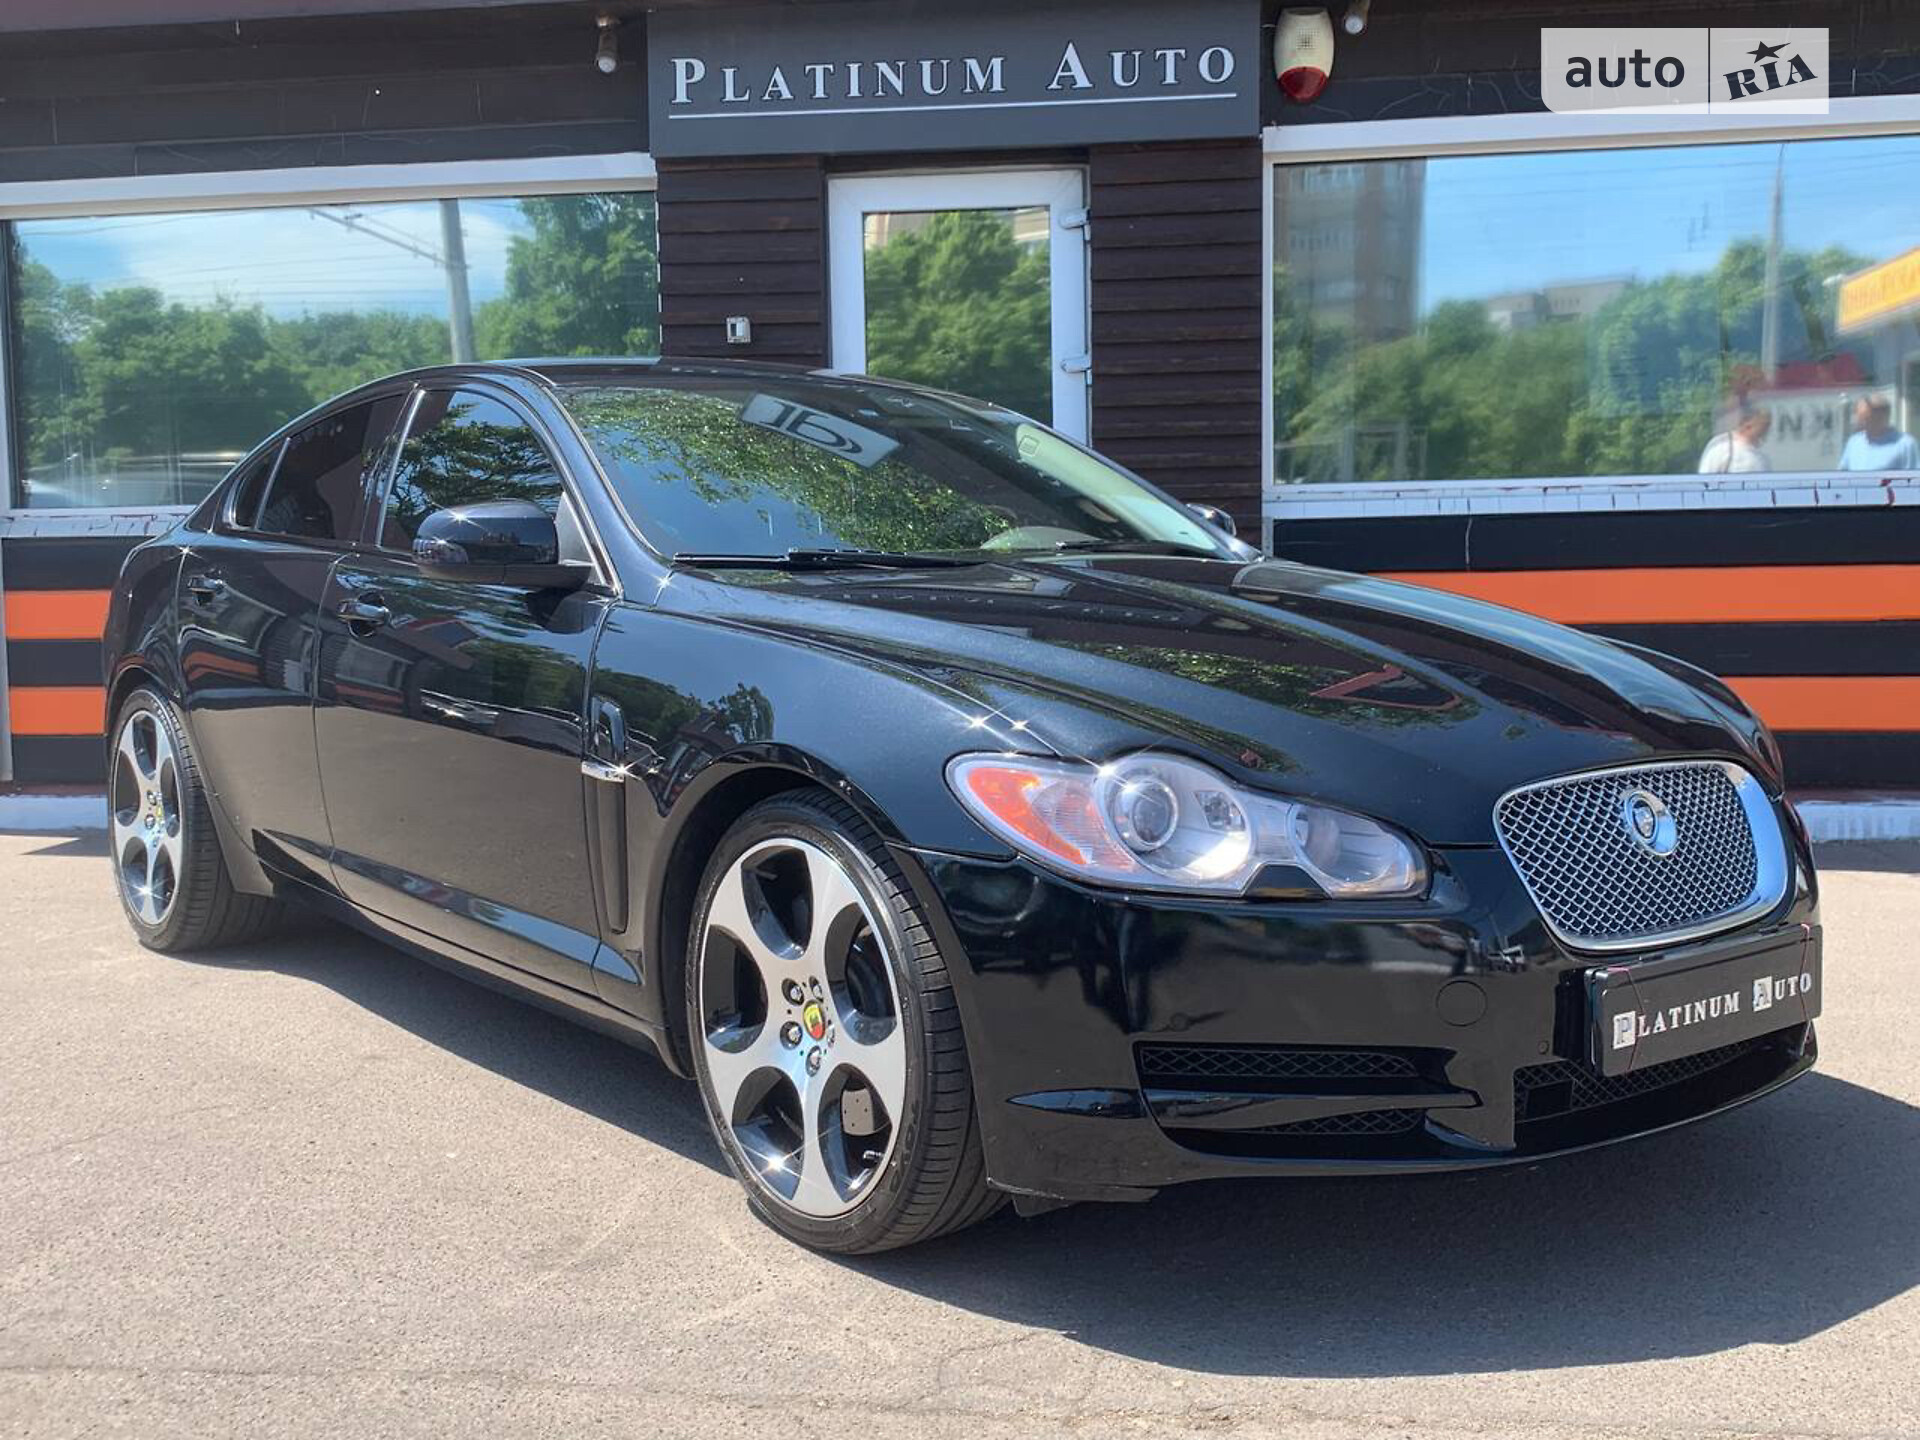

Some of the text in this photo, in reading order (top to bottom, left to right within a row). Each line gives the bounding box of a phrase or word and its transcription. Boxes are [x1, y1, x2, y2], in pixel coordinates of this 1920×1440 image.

[671, 41, 1236, 104] PLATINUM AUTO
[1613, 972, 1812, 1050] PLATINUM AUTO
